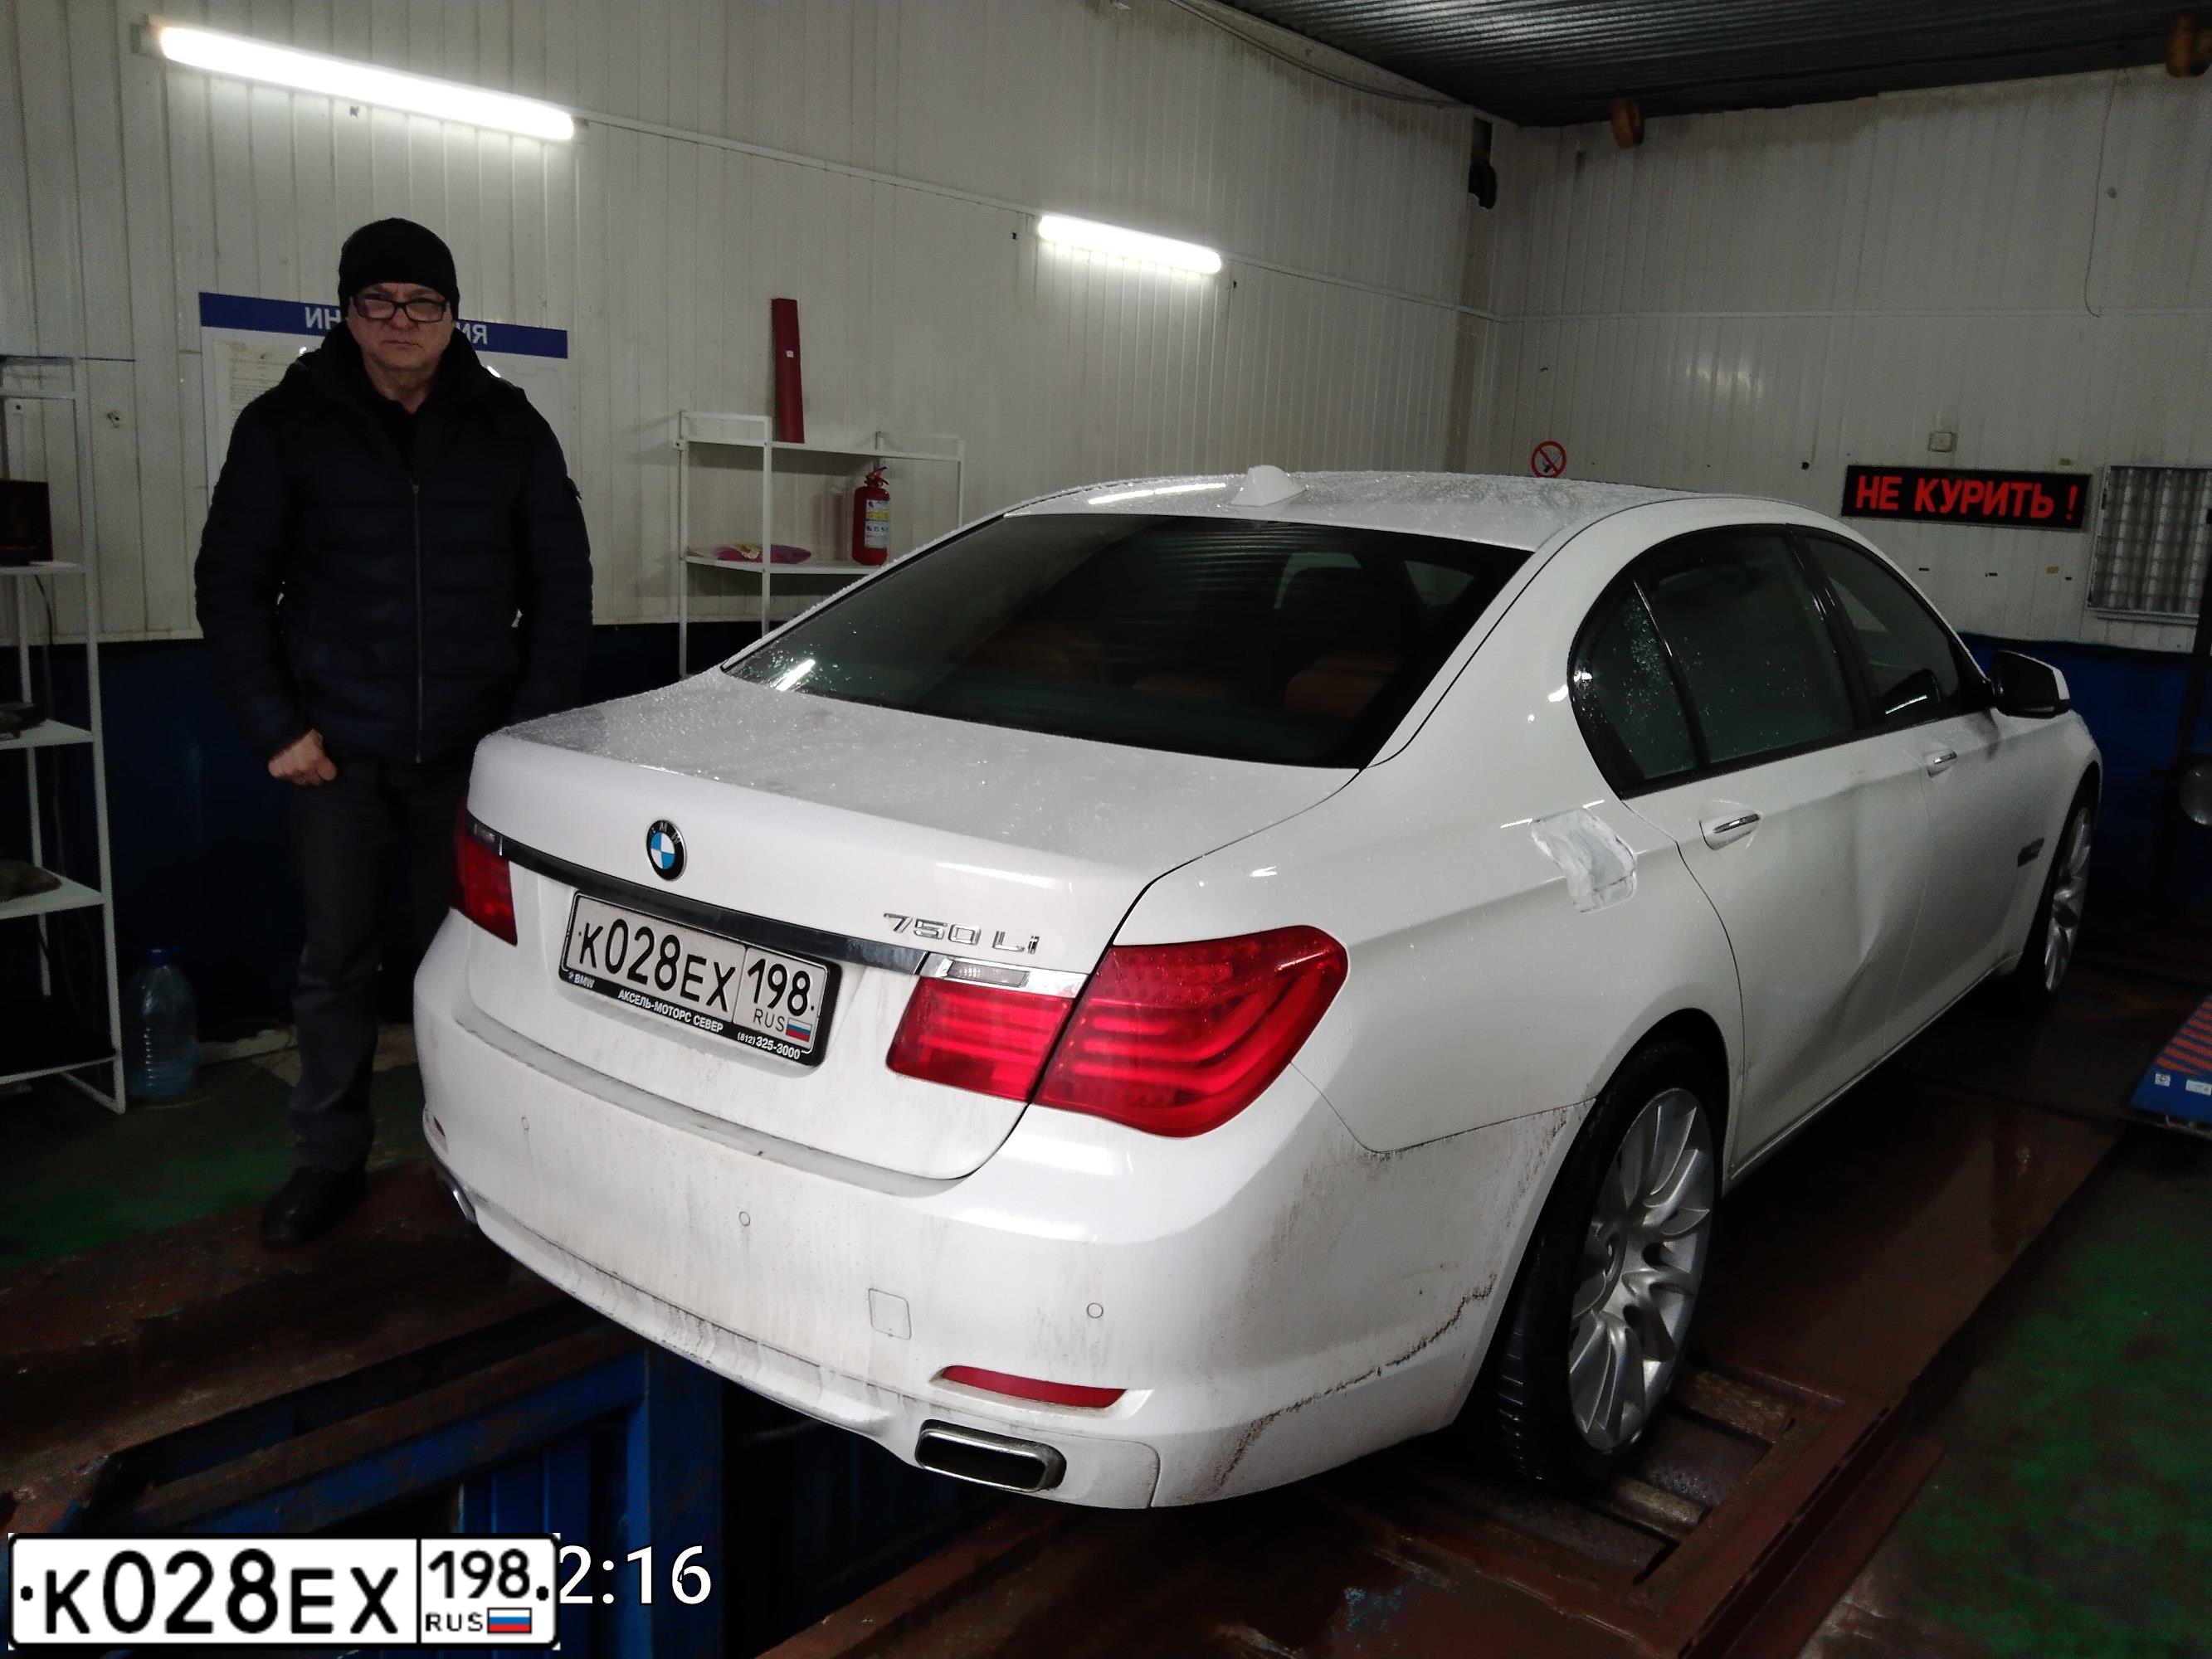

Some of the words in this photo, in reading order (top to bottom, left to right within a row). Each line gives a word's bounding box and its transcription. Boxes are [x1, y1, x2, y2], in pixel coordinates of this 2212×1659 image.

[1855, 475, 1903, 510] НЕ
[1914, 478, 2054, 518] КУРИТЬ
[2065, 484, 2078, 520] !
[883, 912, 982, 946] 750
[574, 973, 596, 989] BMW
[579, 918, 736, 1012] К028ЕХ
[748, 958, 811, 1016] 198
[617, 990, 692, 1023] АКСЕЛЬ-МОТОРС
[693, 1015, 724, 1033] СЕВЕР
[753, 1008, 786, 1033] RUS
[755, 1036, 801, 1060] 325-3000
